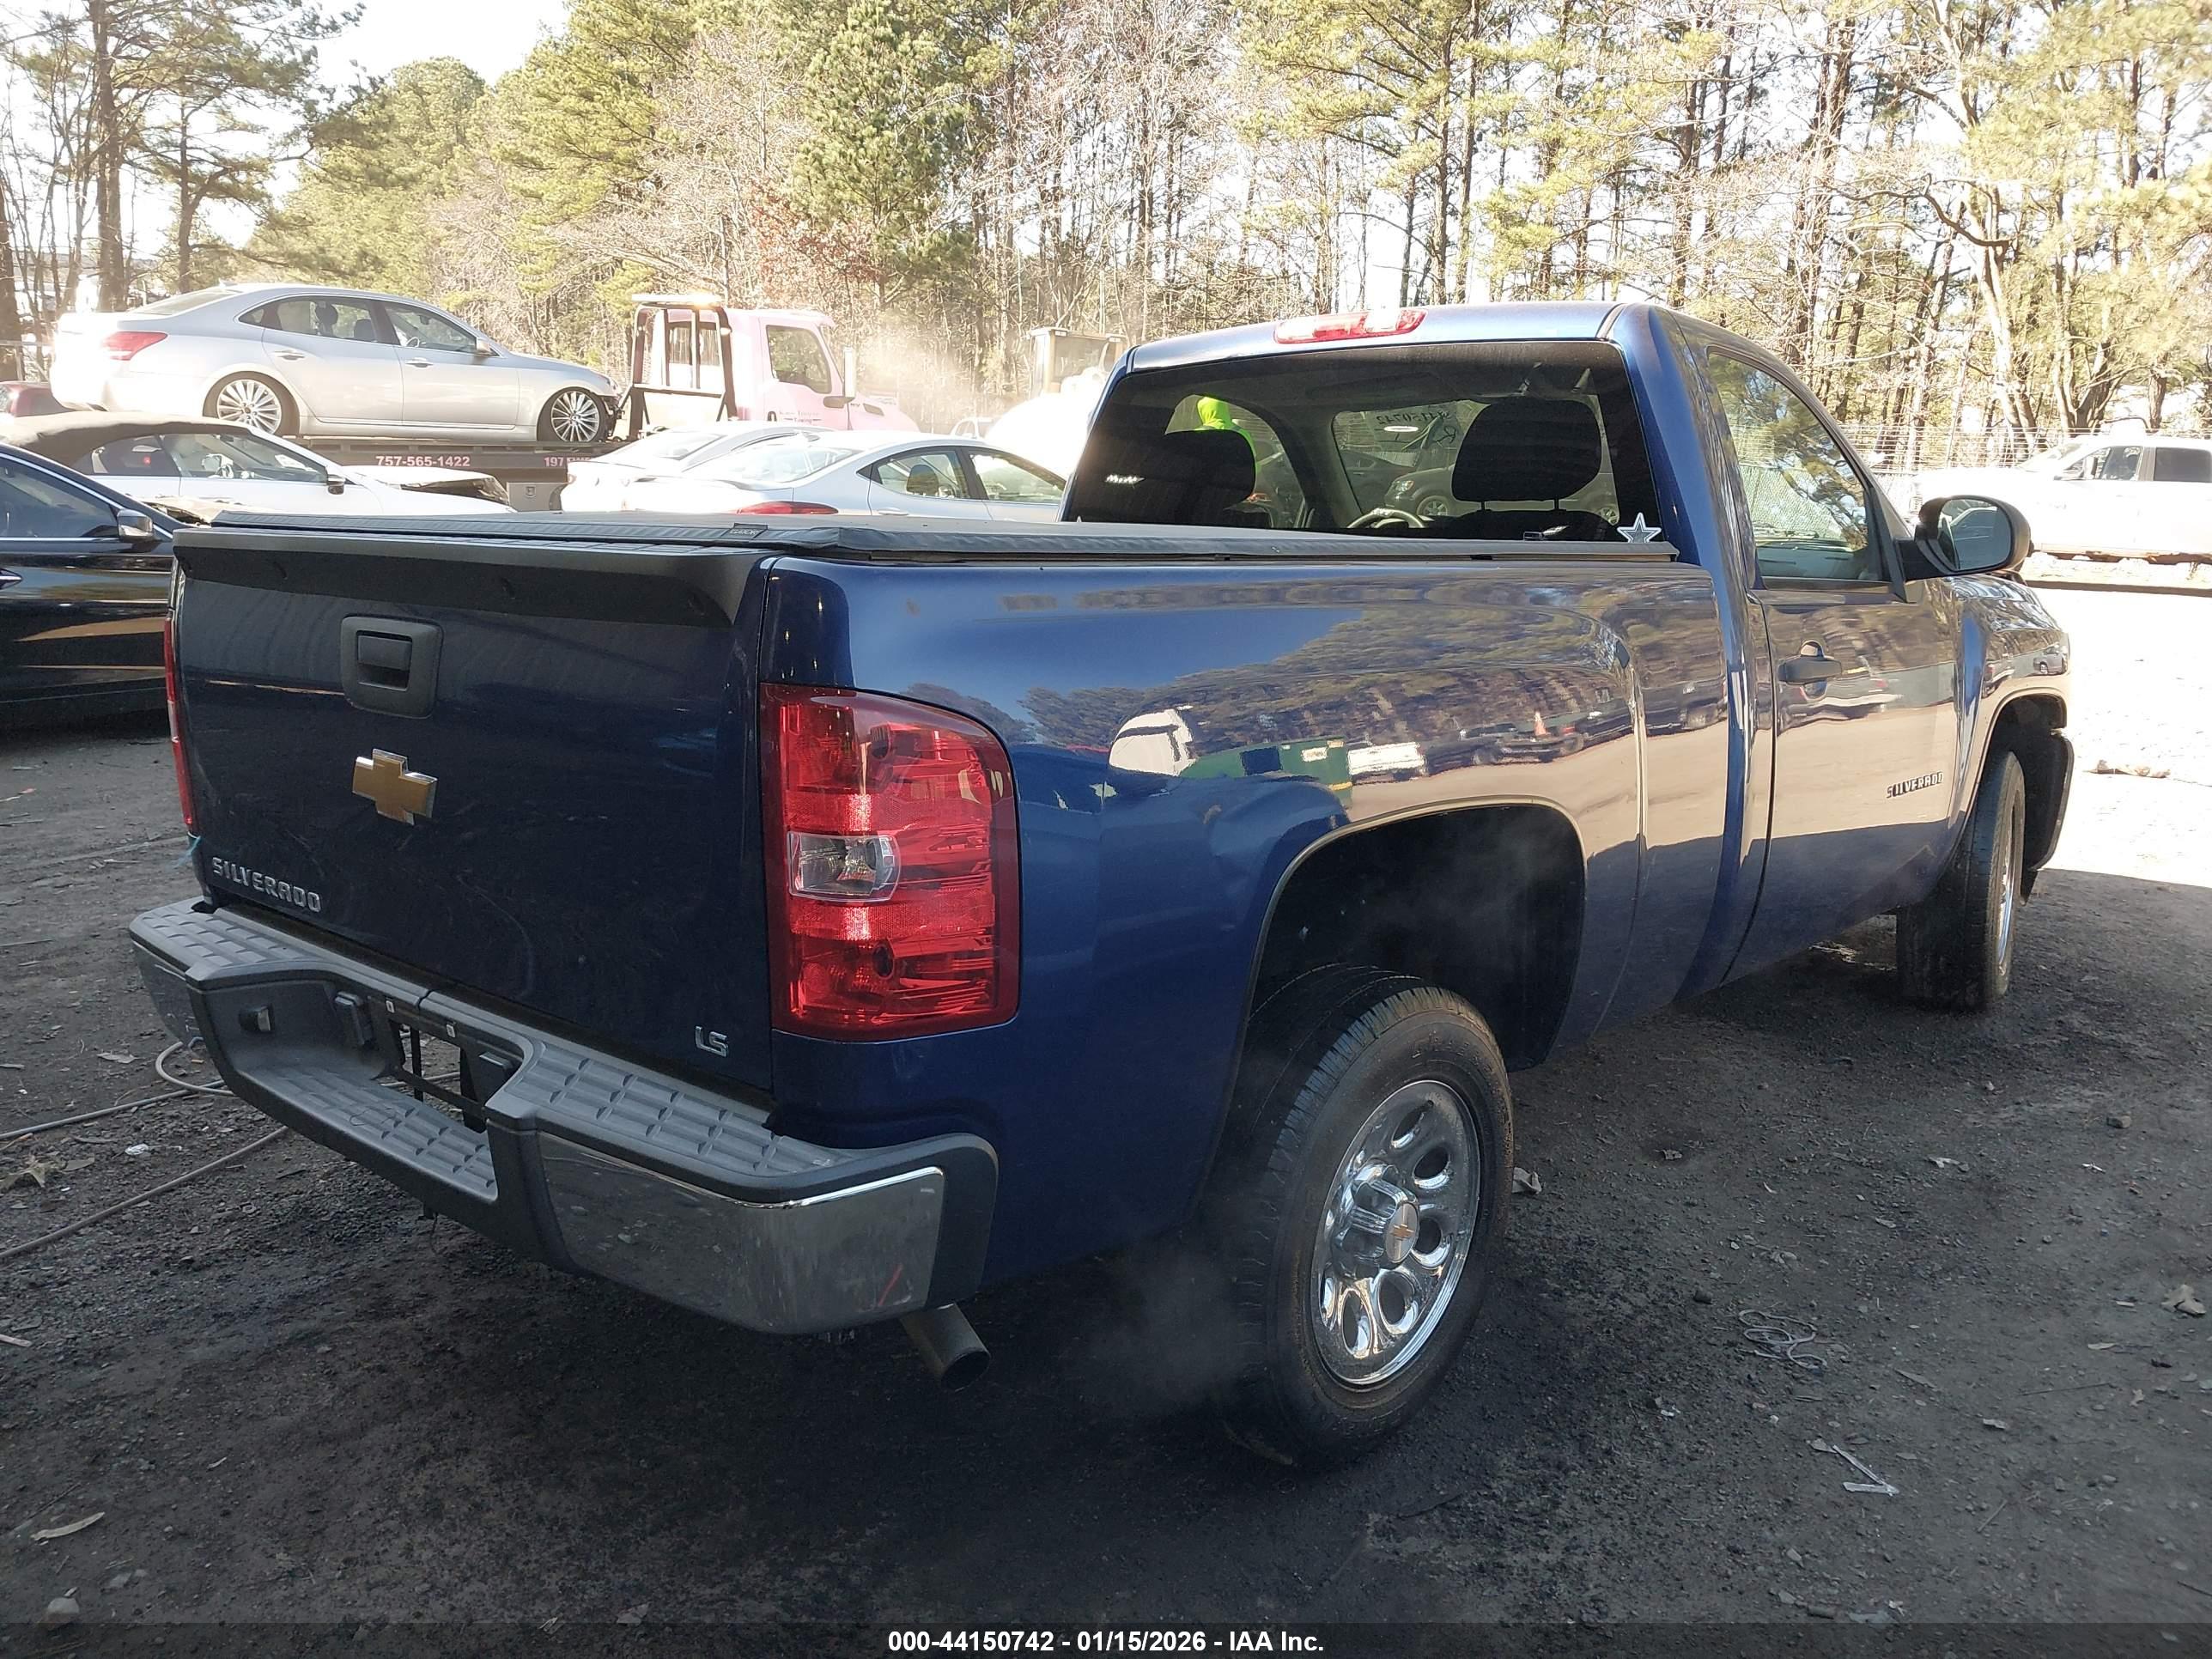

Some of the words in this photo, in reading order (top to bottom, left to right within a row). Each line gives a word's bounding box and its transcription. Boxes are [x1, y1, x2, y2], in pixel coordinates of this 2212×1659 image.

[375, 455, 471, 467] 757-565-1422
[544, 456, 564, 468] 197
[1886, 771, 1944, 799] SILVERADO
[212, 856, 322, 914] SILVERADO
[695, 1025, 729, 1058] LS
